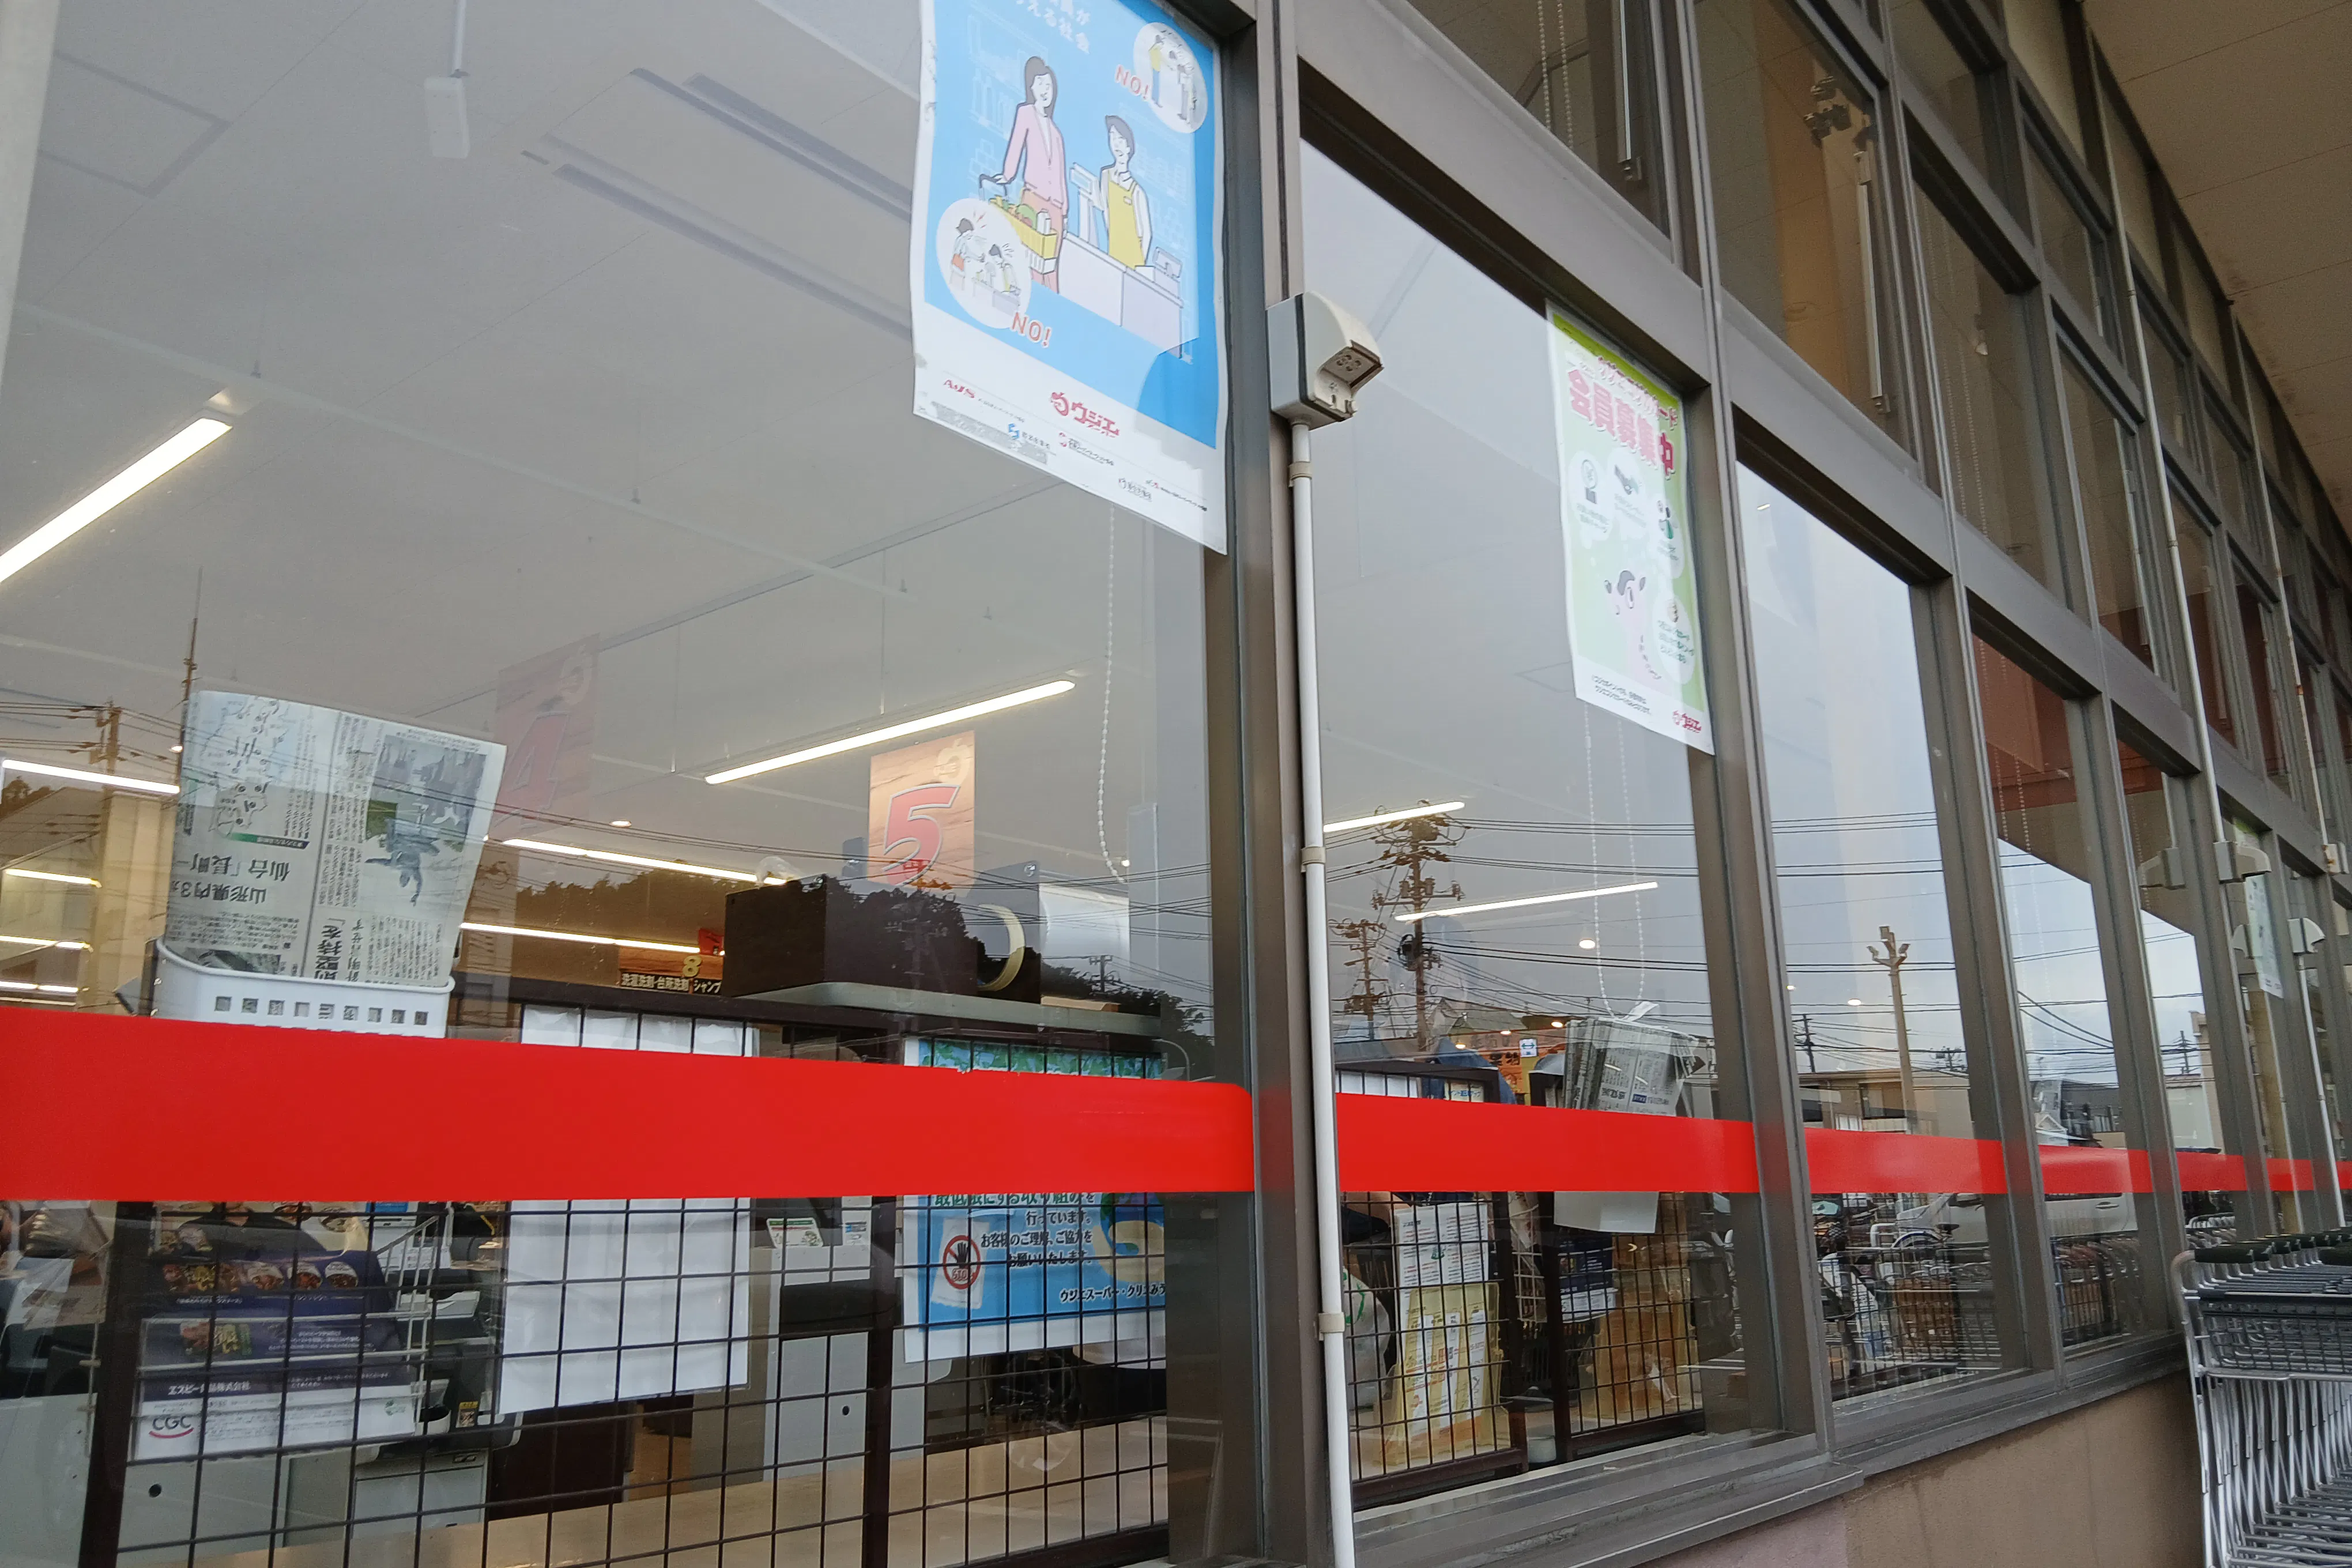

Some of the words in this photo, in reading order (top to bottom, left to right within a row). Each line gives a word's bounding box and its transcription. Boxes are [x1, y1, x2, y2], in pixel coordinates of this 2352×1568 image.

[1115, 65, 1149, 101] NO!
[1012, 312, 1051, 346] NO!
[882, 782, 961, 888] 5
[683, 955, 702, 977] 8
[1026, 1211, 1091, 1226] 行っています。
[981, 1229, 1093, 1247] お客様のご理解、ご協力を
[1008, 1251, 1091, 1268] お願いいたします。
[152, 1416, 191, 1430] CGC
